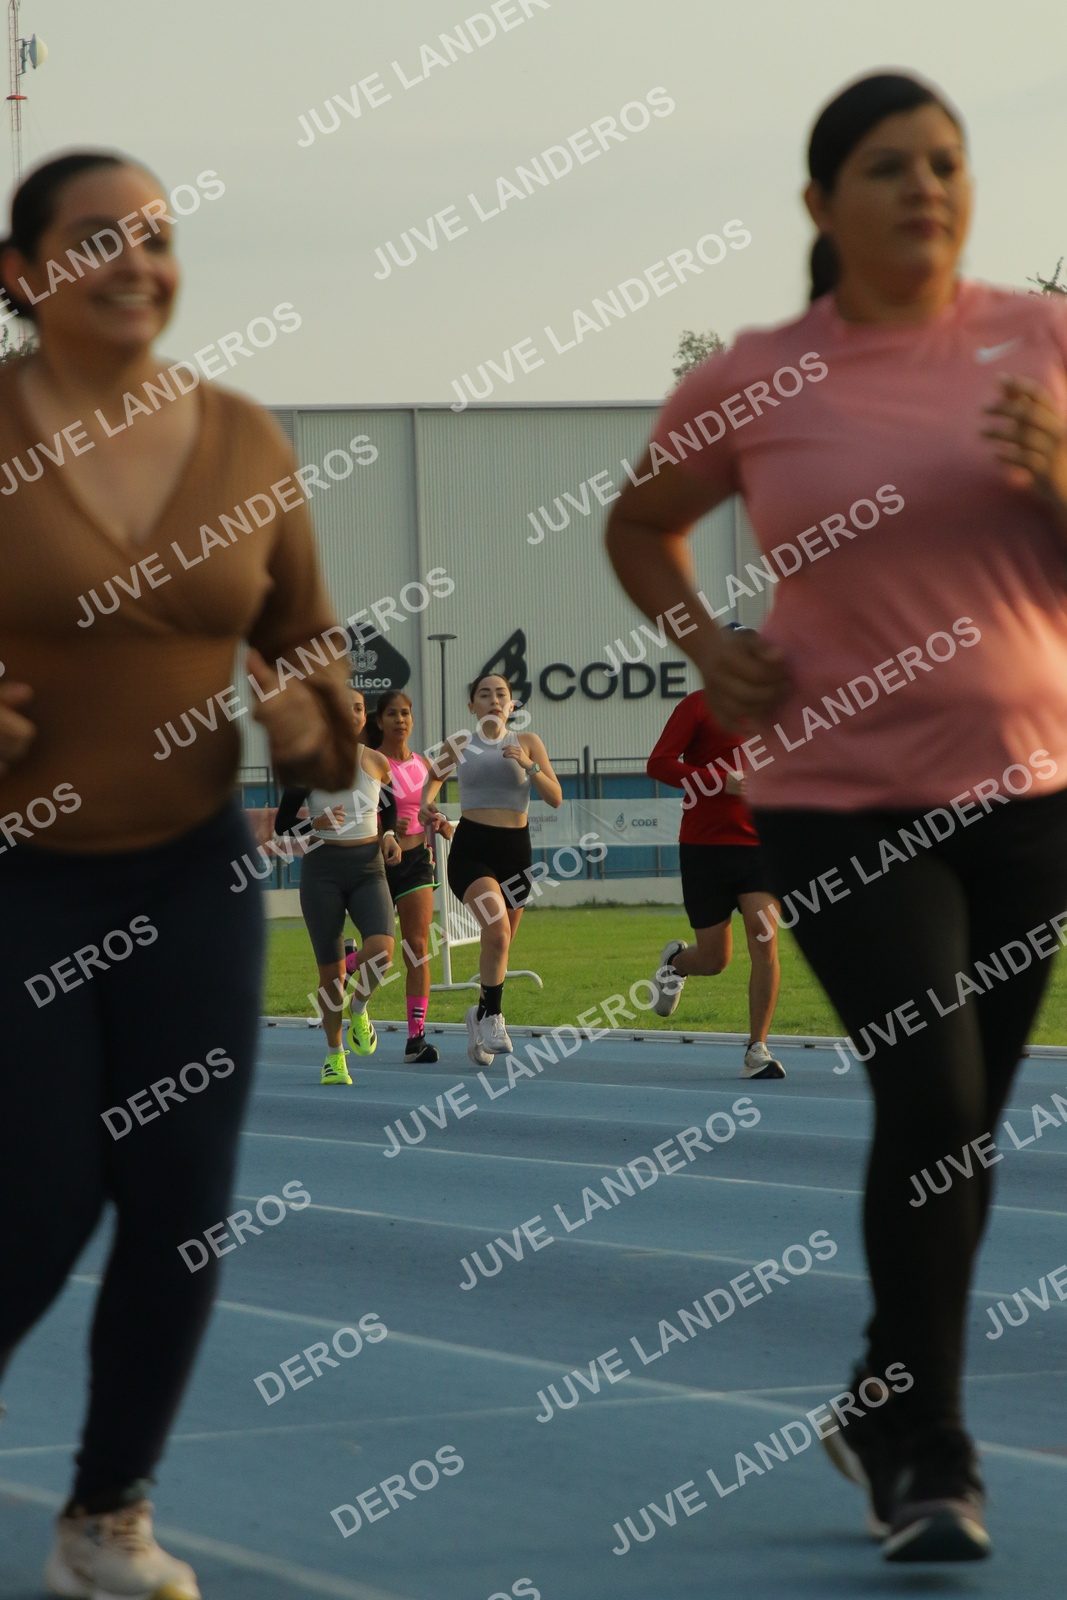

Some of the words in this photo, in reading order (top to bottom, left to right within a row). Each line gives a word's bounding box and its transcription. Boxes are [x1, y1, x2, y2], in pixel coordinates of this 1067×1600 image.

[345, 674, 392, 688] alisco
[540, 661, 688, 702] CODE
[631, 818, 658, 827] CODE
